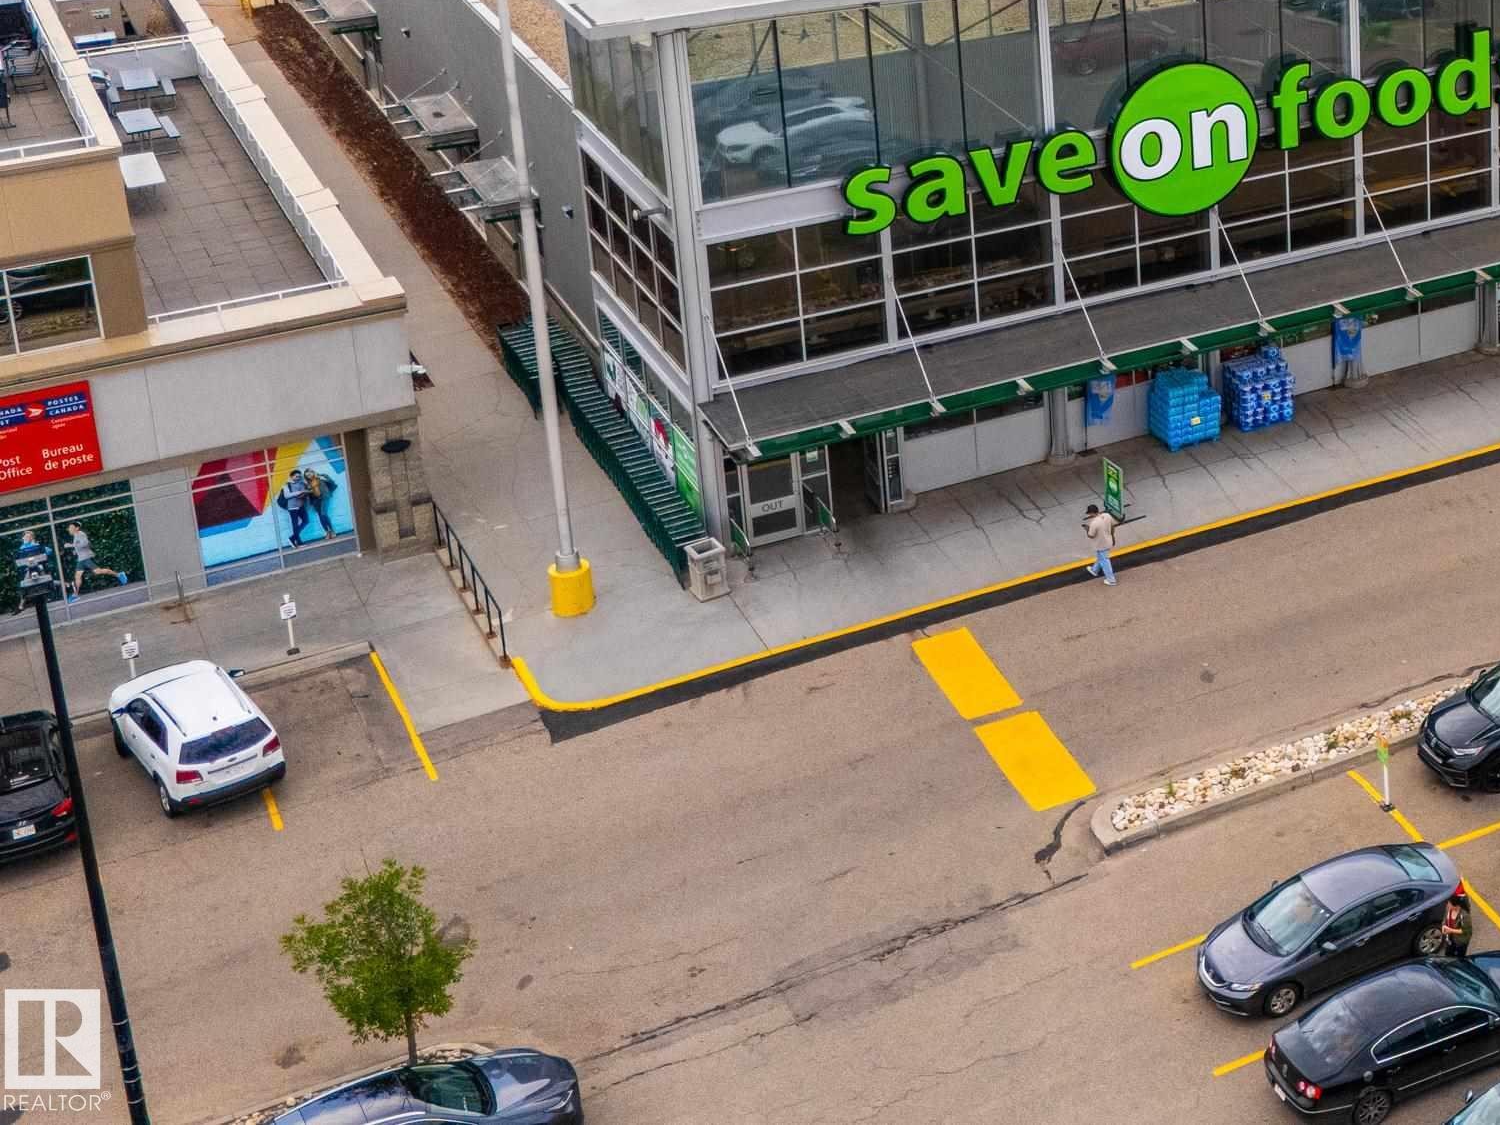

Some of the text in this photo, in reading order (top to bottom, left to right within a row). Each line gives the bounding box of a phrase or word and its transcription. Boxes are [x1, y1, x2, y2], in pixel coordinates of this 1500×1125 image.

[844, 129, 1098, 237] save
[1119, 102, 1249, 182] on
[47, 395, 79, 406] POSTES
[49, 405, 84, 415] CANADA
[41, 443, 84, 459] Bureau
[44, 453, 95, 471] de poste
[0, 466, 33, 481] Office
[762, 500, 784, 512] OUT
